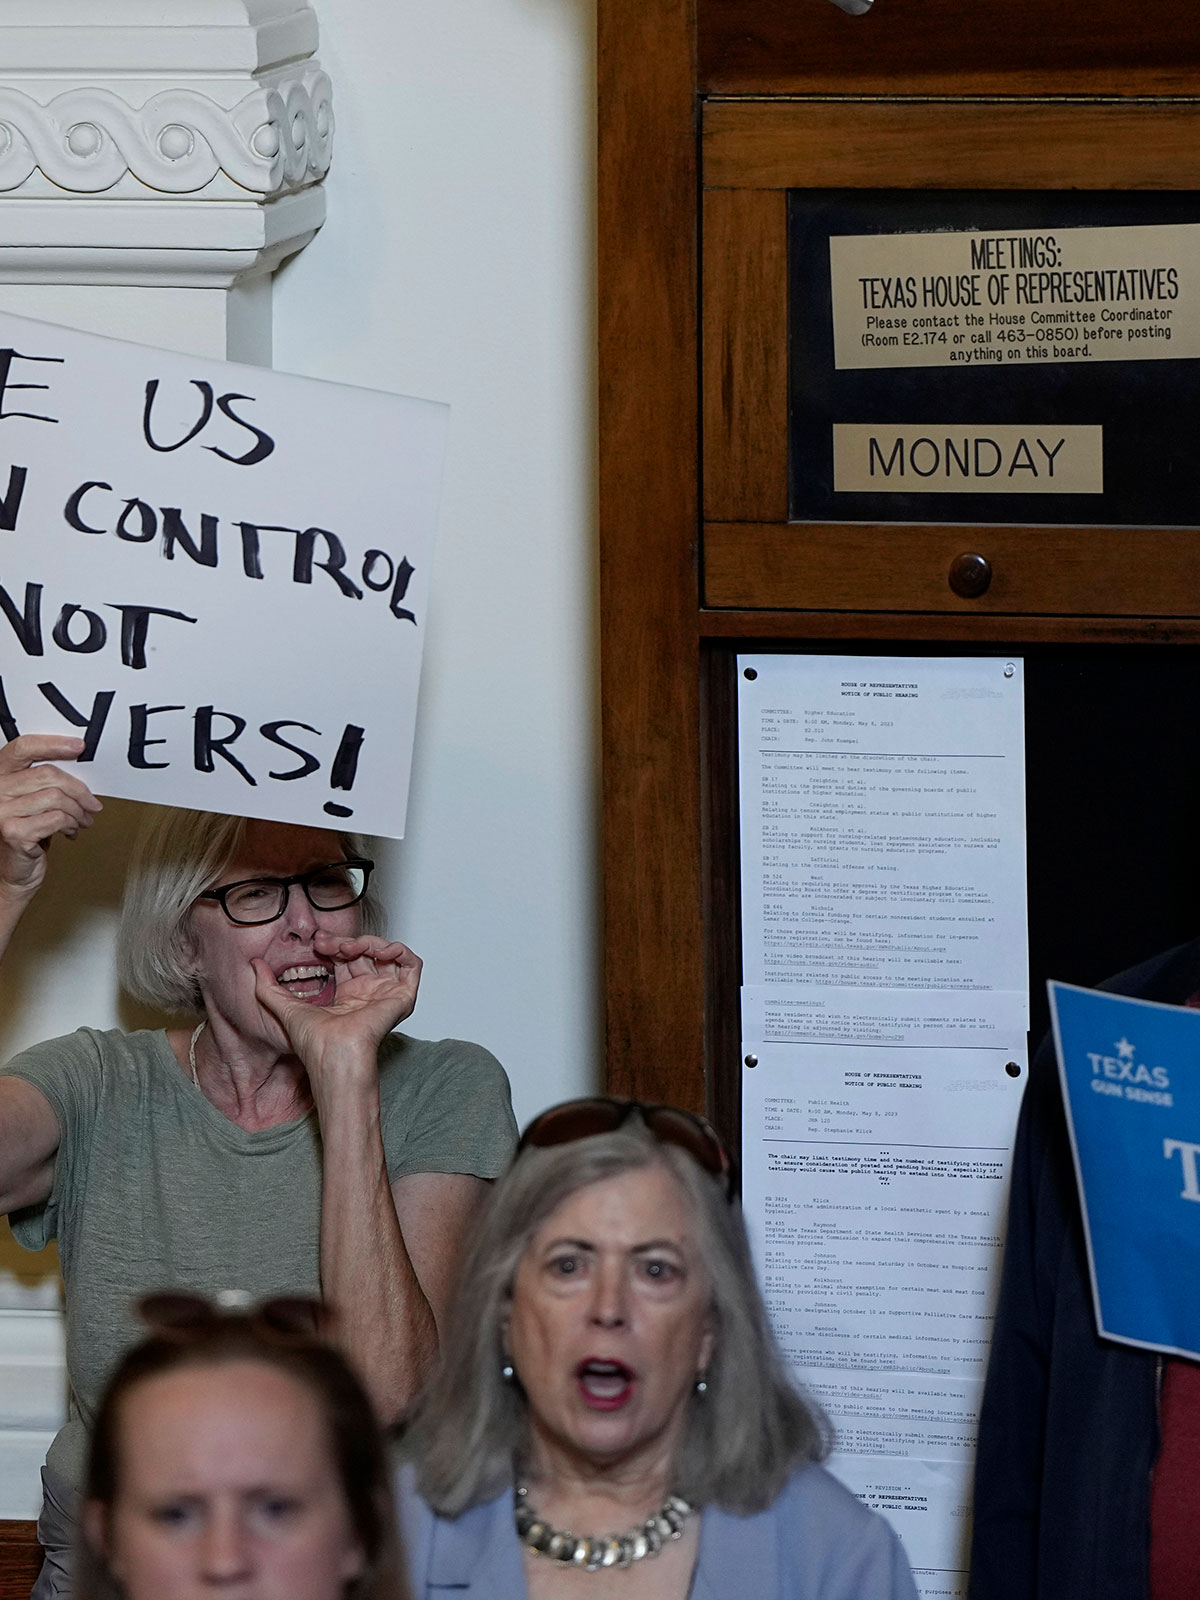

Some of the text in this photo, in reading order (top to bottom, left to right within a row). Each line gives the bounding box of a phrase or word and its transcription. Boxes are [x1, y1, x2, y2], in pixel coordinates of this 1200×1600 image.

[971, 236, 1062, 270] MEETINGS:
[859, 268, 1179, 309] TEXAS HOUSE OF REPRESENTATIVES
[866, 308, 1173, 329] Please contact the House Committee Coordinator
[861, 325, 1171, 347] (Room E2.174 or call 463-0850) before posting
[950, 344, 1092, 362] anything on this board.
[143, 378, 275, 466] US
[868, 437, 1066, 477] MONDAY
[64, 481, 417, 627] CONTROL
[1086, 1052, 1170, 1089] TEXAS
[1090, 1079, 1173, 1107] GUN SENSE
[874, 1169, 897, 1177] hearing
[954, 1166, 987, 1174] especially
